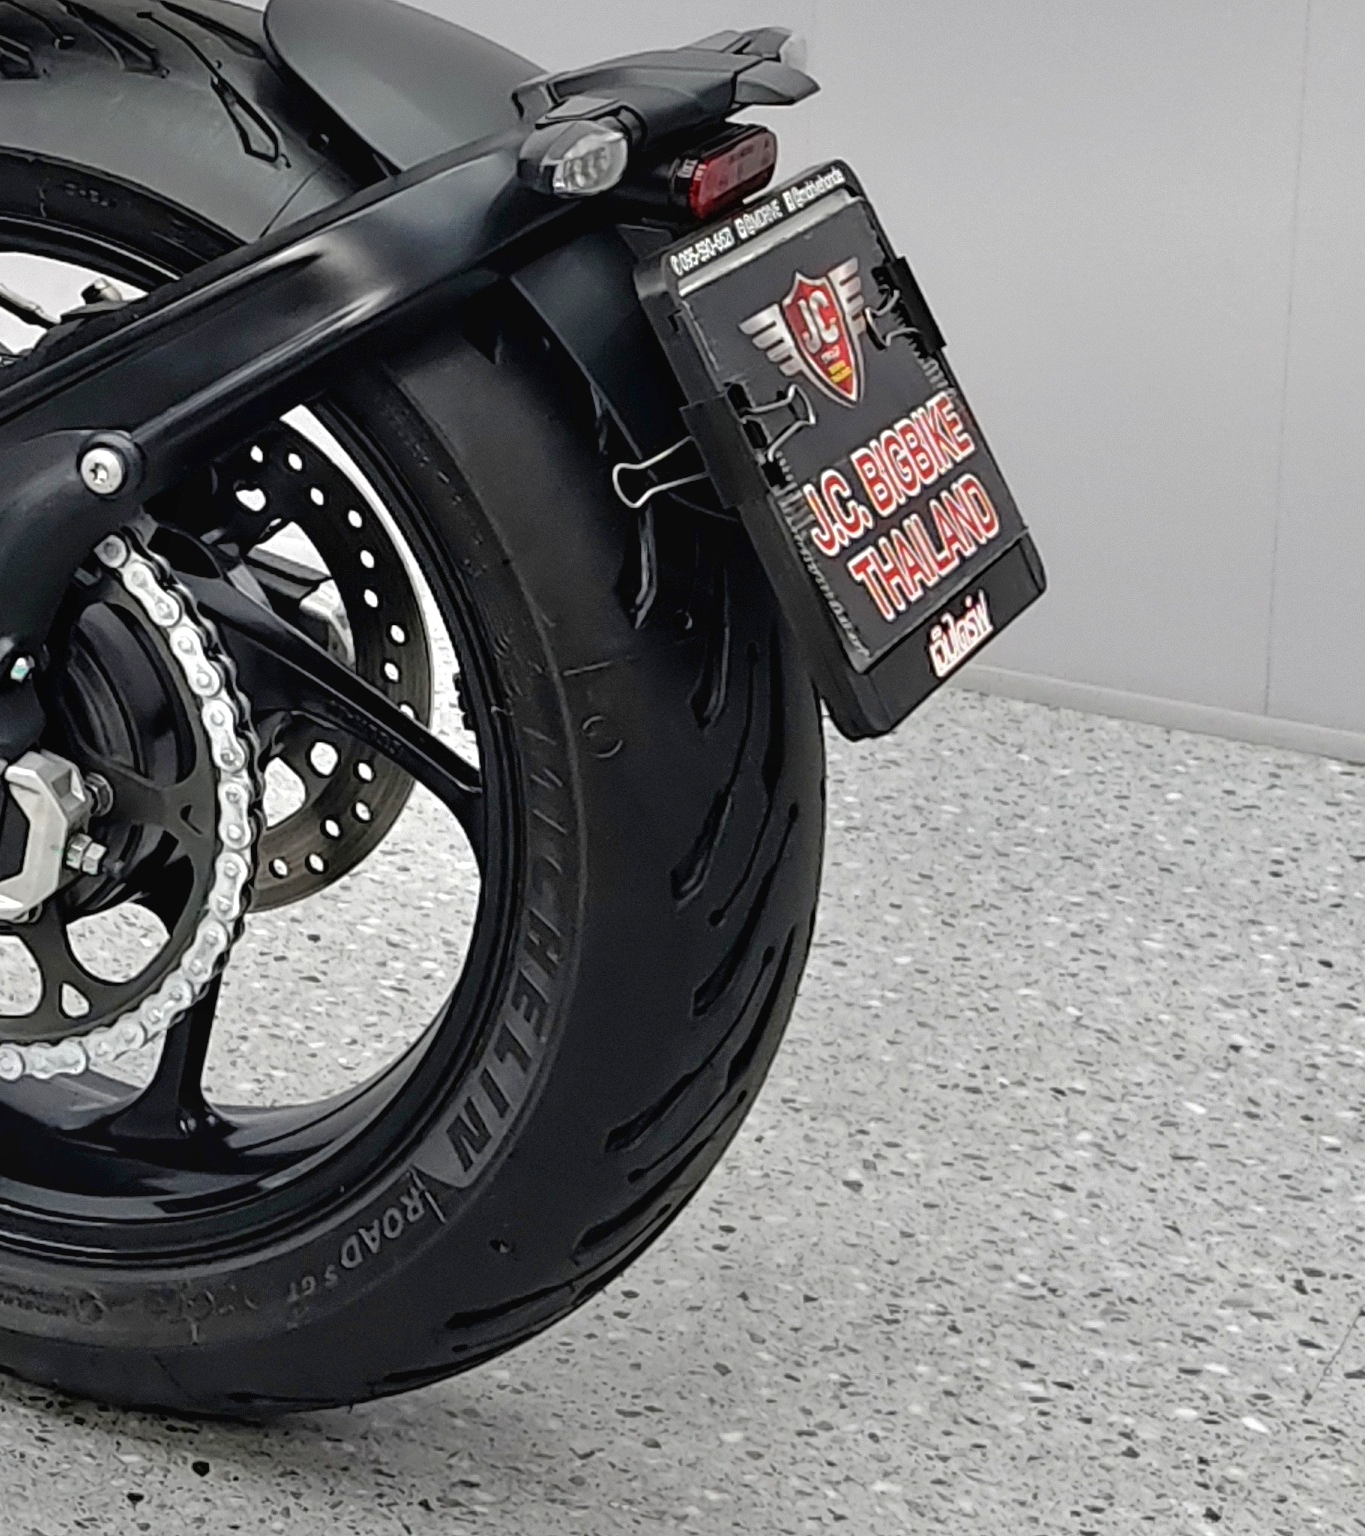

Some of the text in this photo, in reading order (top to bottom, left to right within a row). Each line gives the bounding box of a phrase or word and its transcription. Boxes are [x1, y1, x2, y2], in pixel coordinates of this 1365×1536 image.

[798, 290, 839, 353] JC
[803, 392, 975, 557] J.C. BIGBIKE
[850, 474, 1000, 623] THAILAND
[341, 1182, 426, 1270] ROAD
